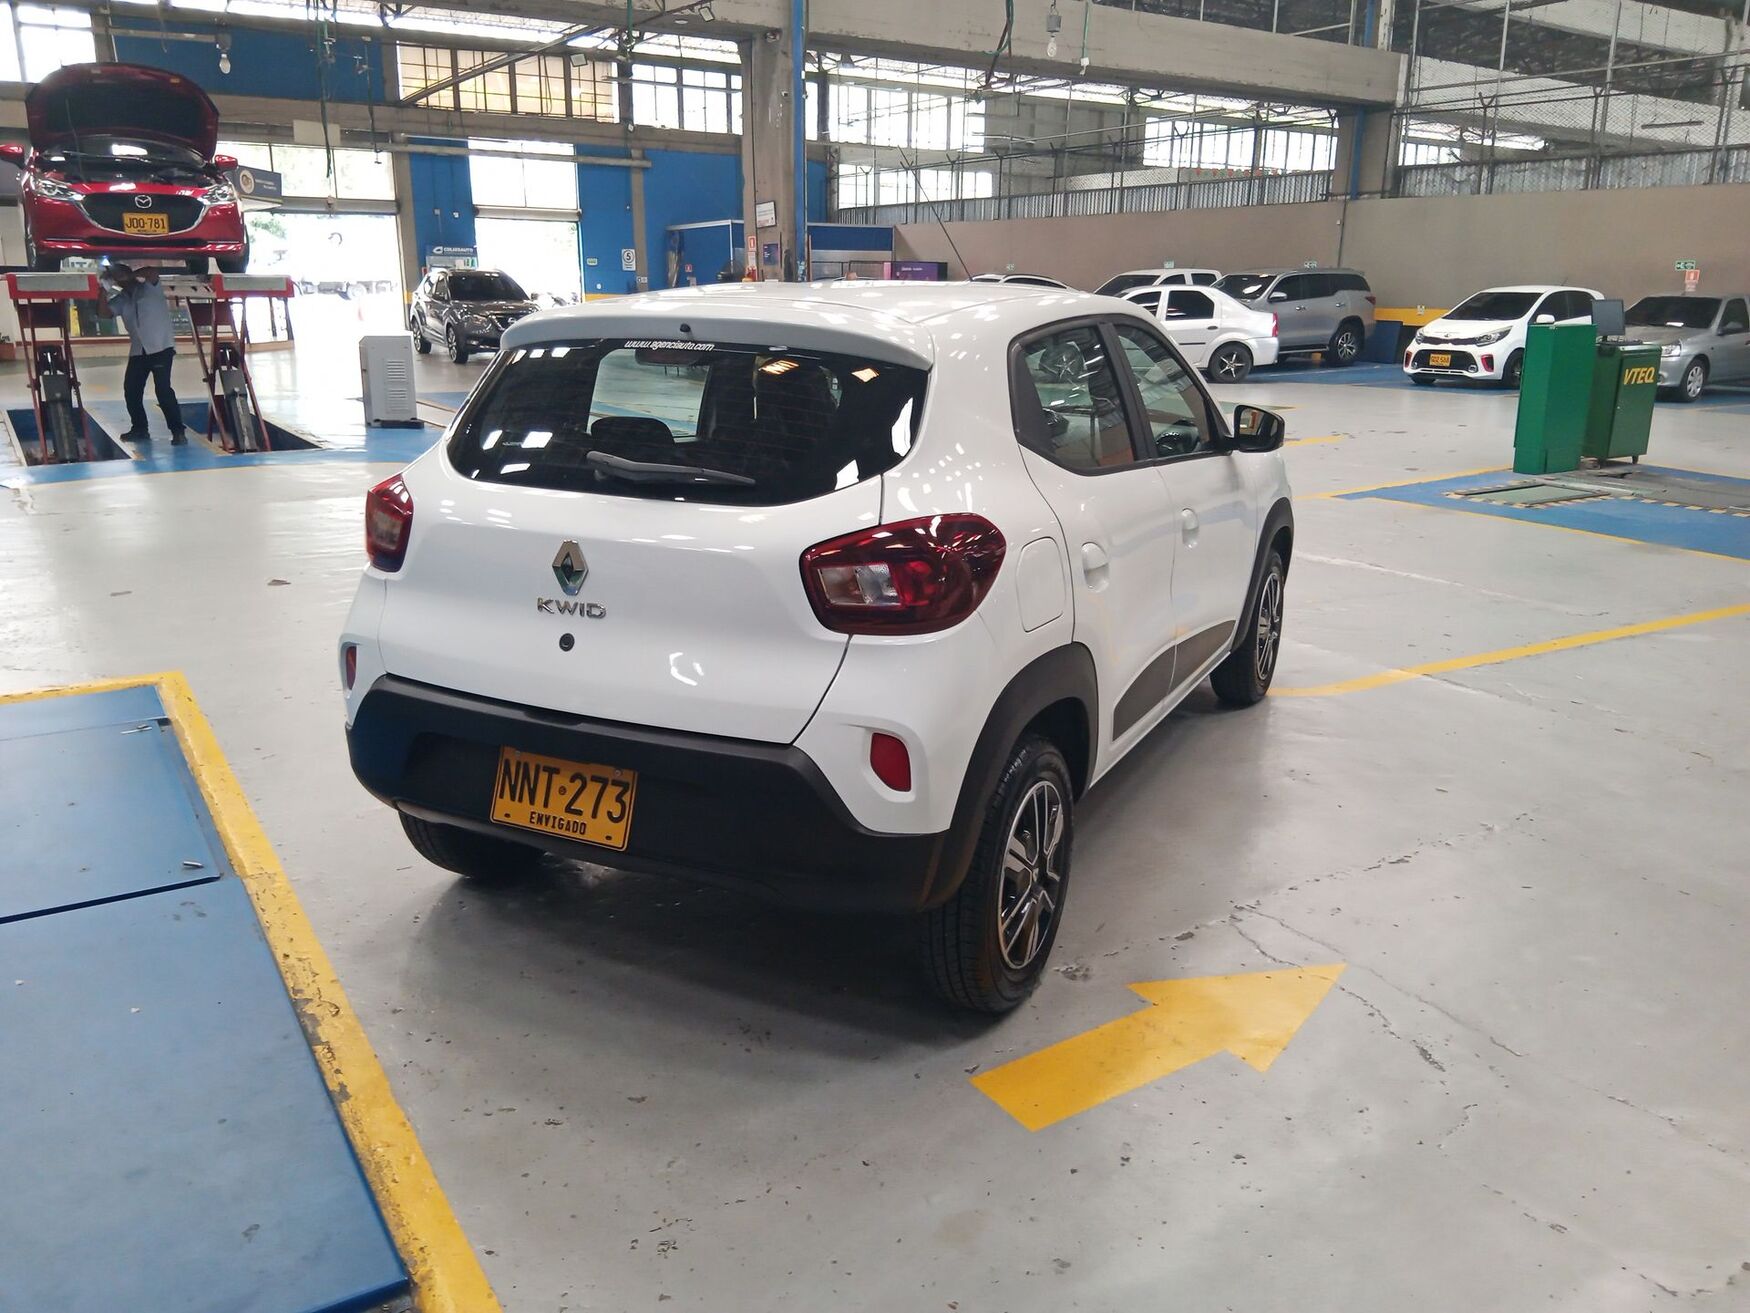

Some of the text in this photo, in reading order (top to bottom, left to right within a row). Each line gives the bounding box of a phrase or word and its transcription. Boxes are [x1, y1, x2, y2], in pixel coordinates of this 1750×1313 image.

[1623, 366, 1655, 385] VTEQ
[537, 597, 607, 619] KWID
[529, 811, 587, 835] ENVIGADO
